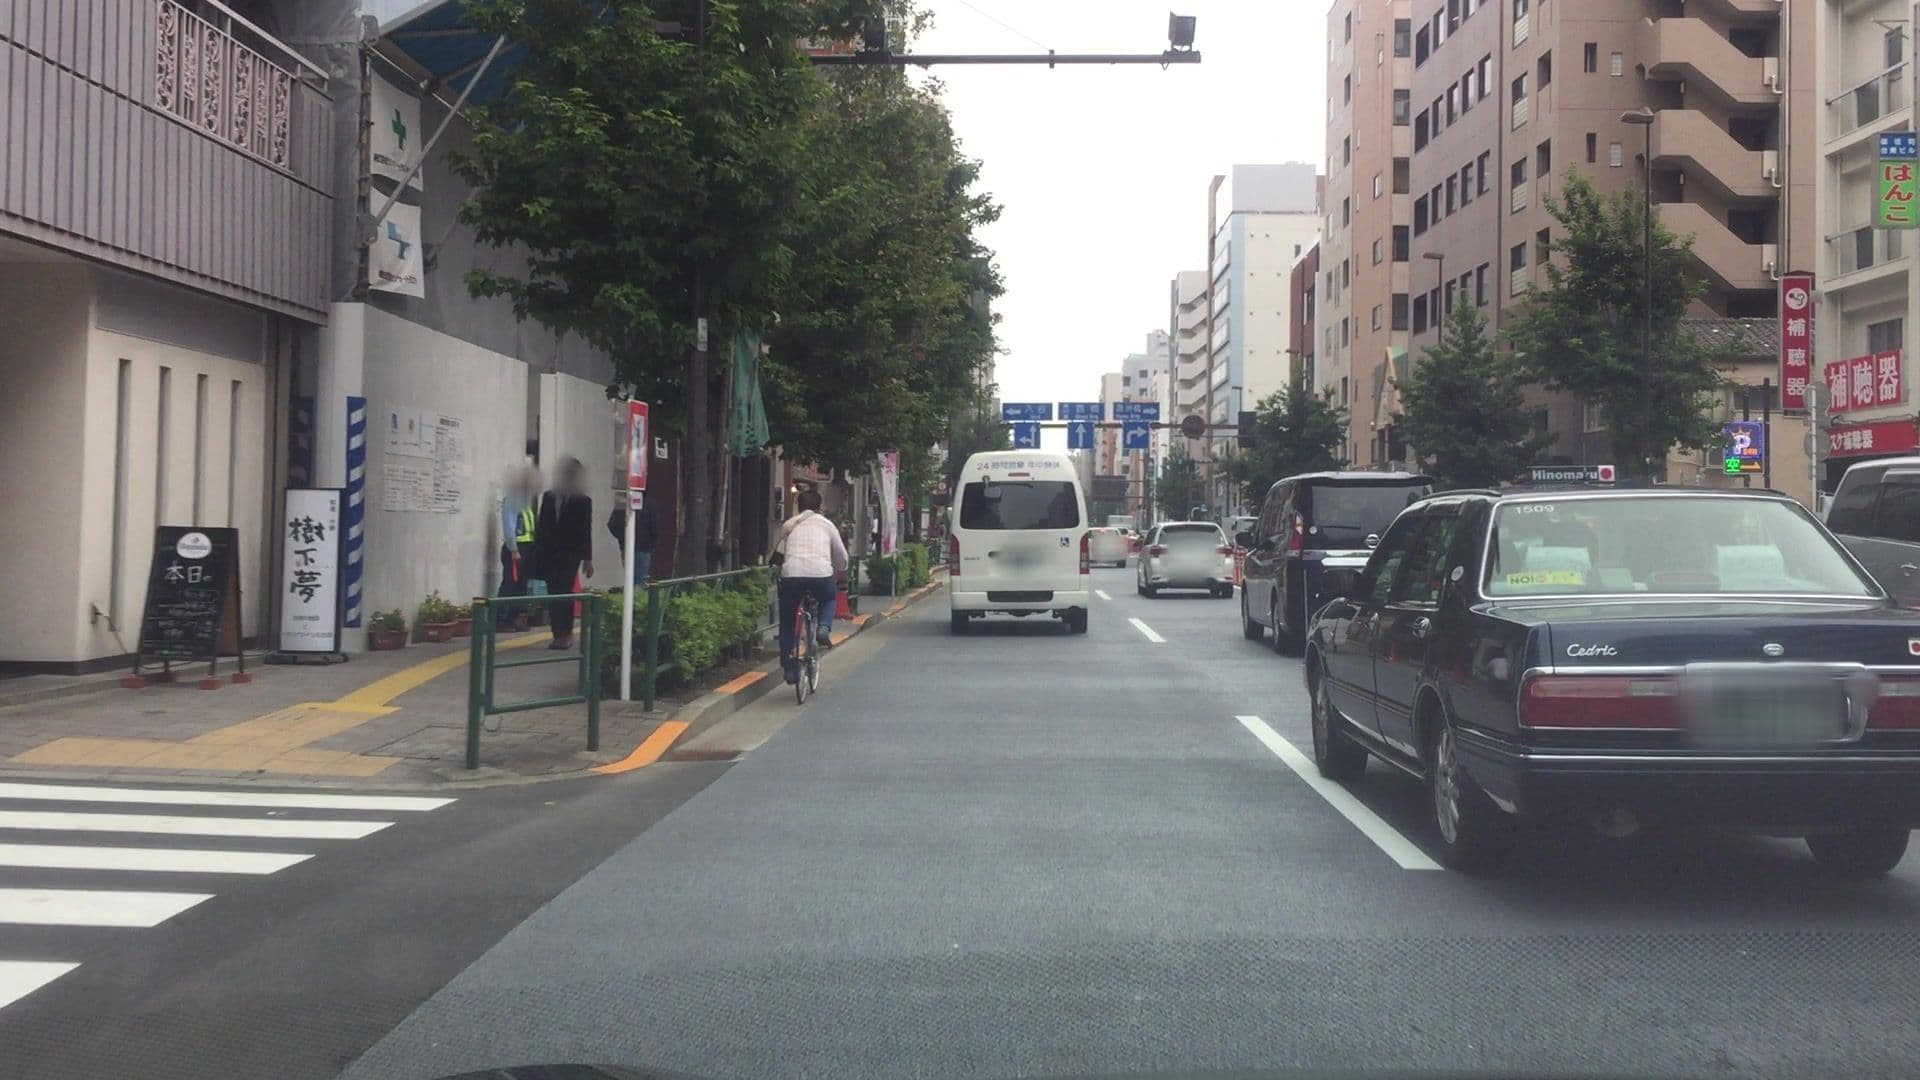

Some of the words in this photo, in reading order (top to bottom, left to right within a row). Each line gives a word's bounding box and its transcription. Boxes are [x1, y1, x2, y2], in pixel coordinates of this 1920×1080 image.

[1885, 164, 1913, 222] はんこ
[1787, 318, 1806, 396] 補聴器
[1829, 355, 1899, 408] 補聴器
[1532, 470, 1597, 480] Hinomaru
[1516, 504, 1554, 514] 1509
[288, 515, 325, 604] 樹下夢
[1567, 643, 1618, 656] Cedric
